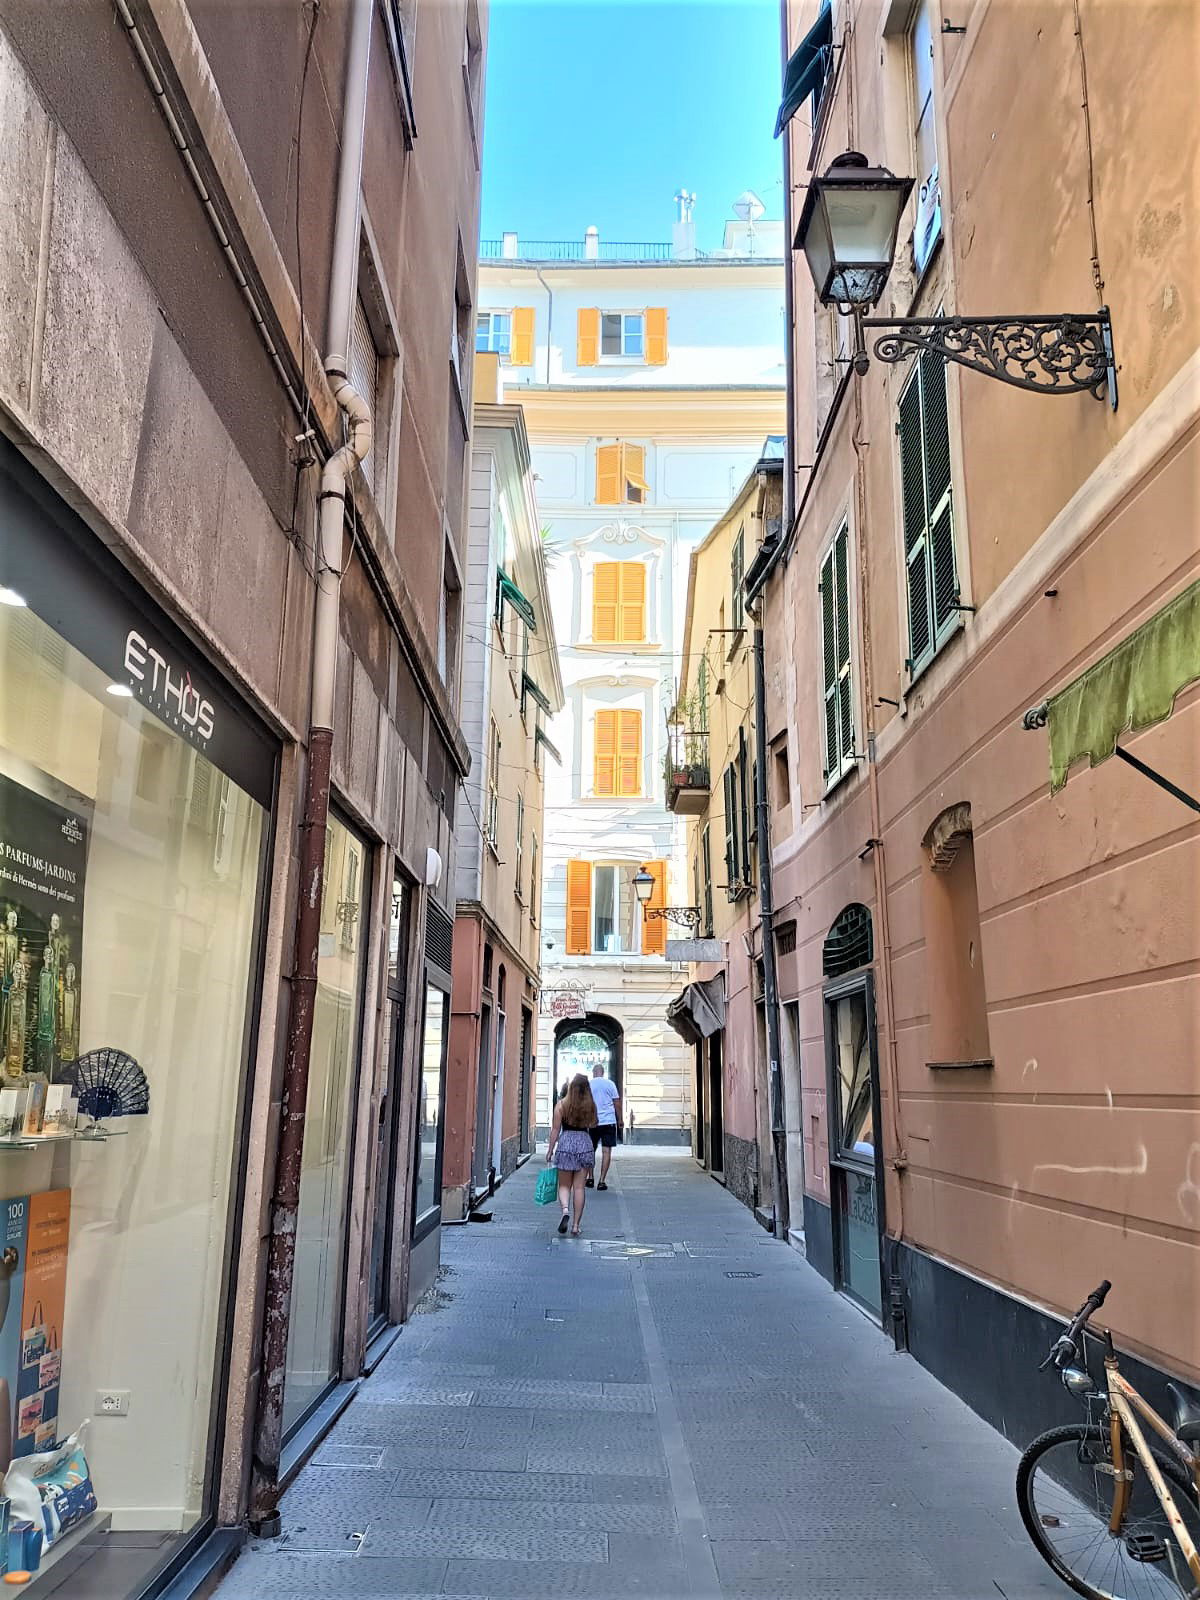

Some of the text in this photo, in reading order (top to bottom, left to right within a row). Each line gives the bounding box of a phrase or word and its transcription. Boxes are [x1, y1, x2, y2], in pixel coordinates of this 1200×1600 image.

[124, 630, 214, 739] ETHOS
[6, 845, 77, 884] PARFUMS-JARDINS
[8, 1203, 24, 1219] 100
